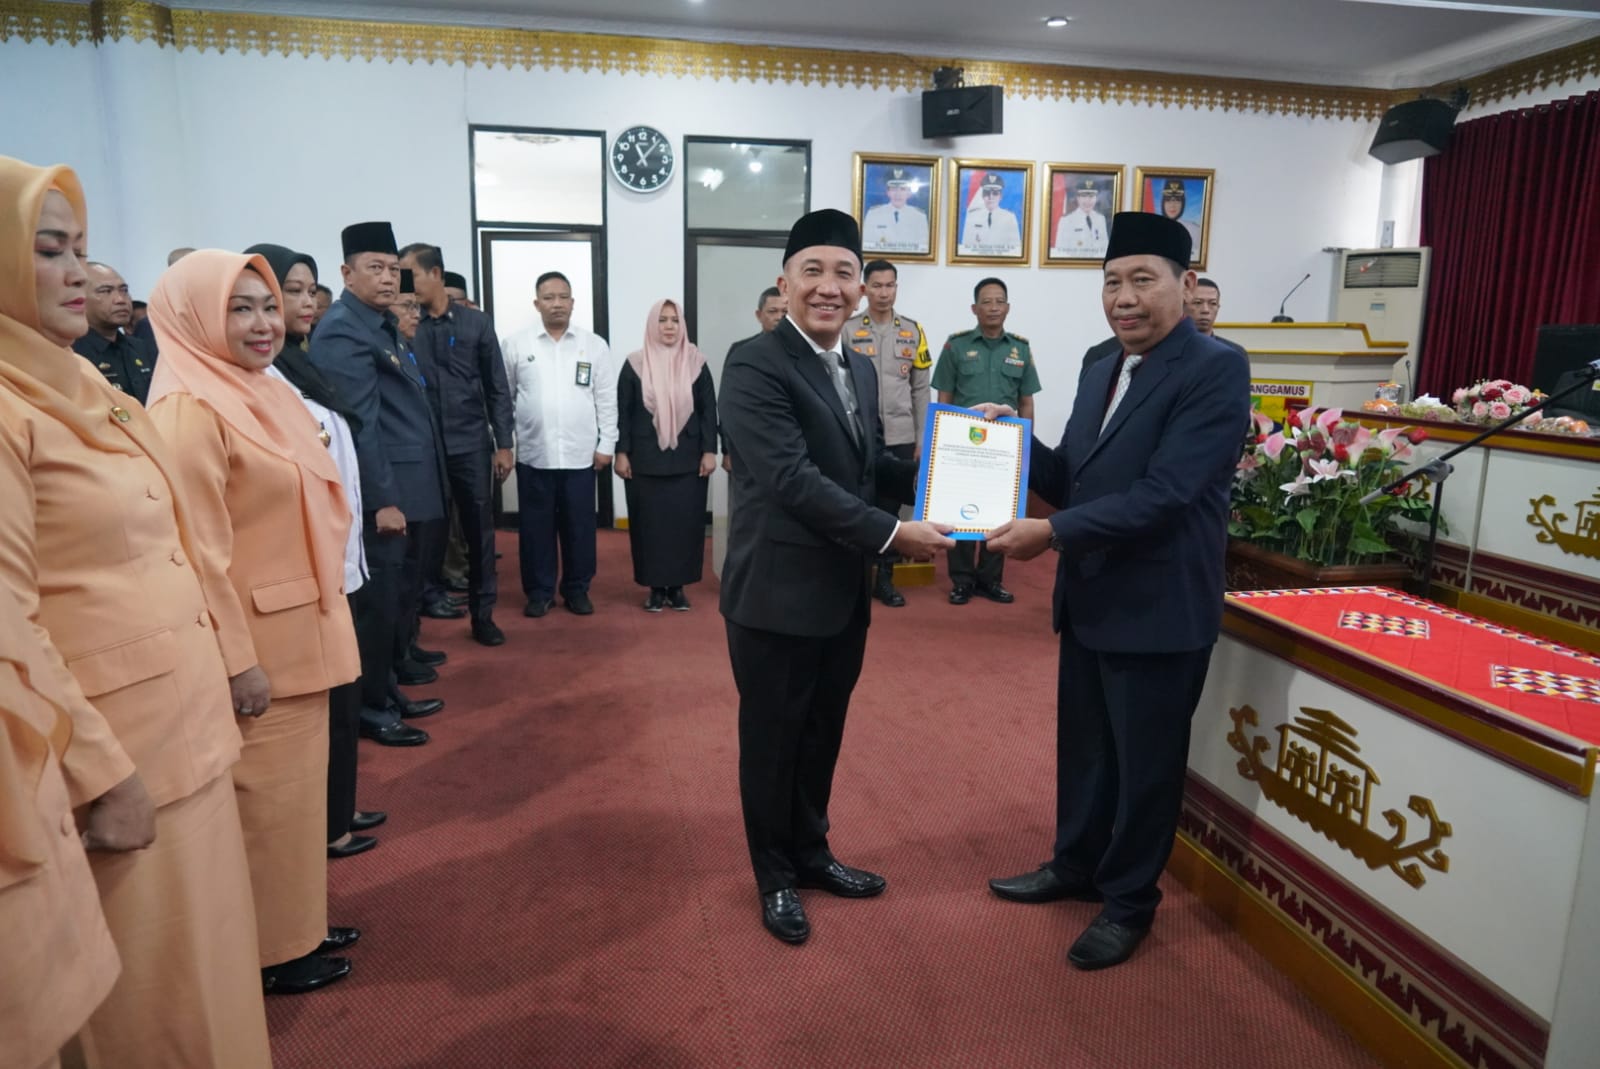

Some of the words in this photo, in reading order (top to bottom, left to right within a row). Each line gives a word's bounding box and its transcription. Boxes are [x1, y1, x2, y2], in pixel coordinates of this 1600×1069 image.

[638, 132, 647, 140] 12
[620, 142, 630, 151] 10
[659, 144, 666, 152] 2
[617, 154, 624, 162] 9
[662, 156, 668, 164] 3
[621, 165, 628, 173] 8
[629, 174, 635, 182] 7
[640, 177, 646, 186] 6
[651, 174, 657, 183] 5
